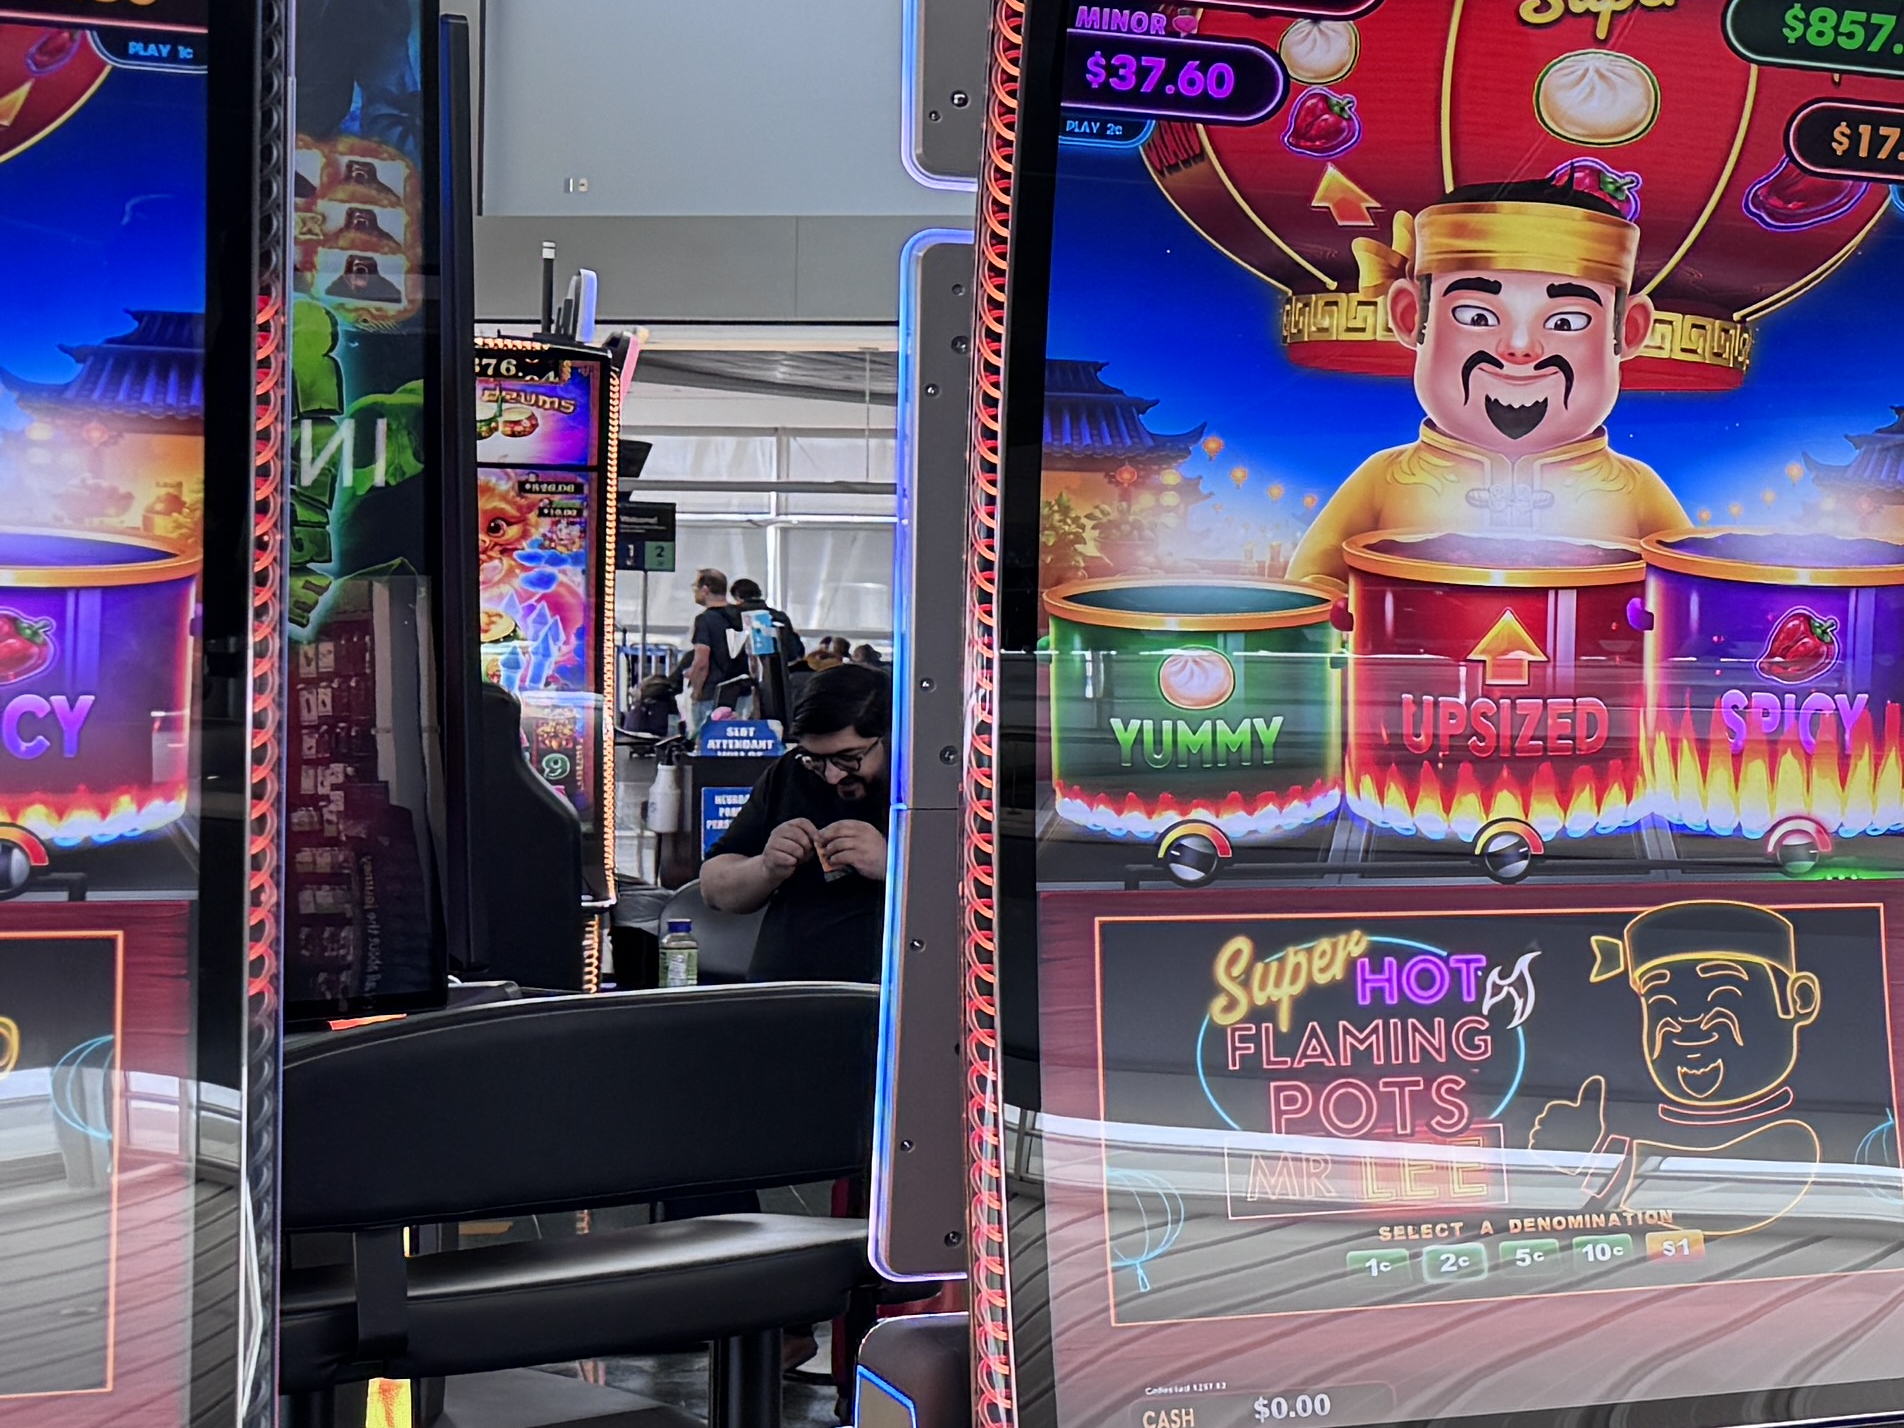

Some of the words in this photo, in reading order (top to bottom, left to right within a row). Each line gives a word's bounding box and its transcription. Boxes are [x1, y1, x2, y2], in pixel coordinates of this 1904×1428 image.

[1076, 6, 1166, 35] MINOR
[129, 41, 171, 58] PLAY
[1085, 51, 1235, 98] $37.60
[707, 739, 775, 750] ATTENDANT
[1109, 717, 1284, 768] YUMMY
[1401, 695, 1609, 757] UPSIZED
[1720, 689, 1869, 754] SPICY
[542, 753, 570, 780] 9
[1210, 929, 1369, 1033] Super
[1357, 955, 1487, 1005] HOT
[1227, 1016, 1492, 1070] FLAMING
[1270, 1075, 1470, 1137] POTS
[1247, 1152, 1337, 1202] MR
[1359, 1136, 1490, 1202] LEE
[1379, 1222, 1465, 1242] SELECT
[1480, 1221, 1495, 1236] A
[1509, 1209, 1675, 1235] DENOMINATION
[1253, 1393, 1332, 1423] $0.00
